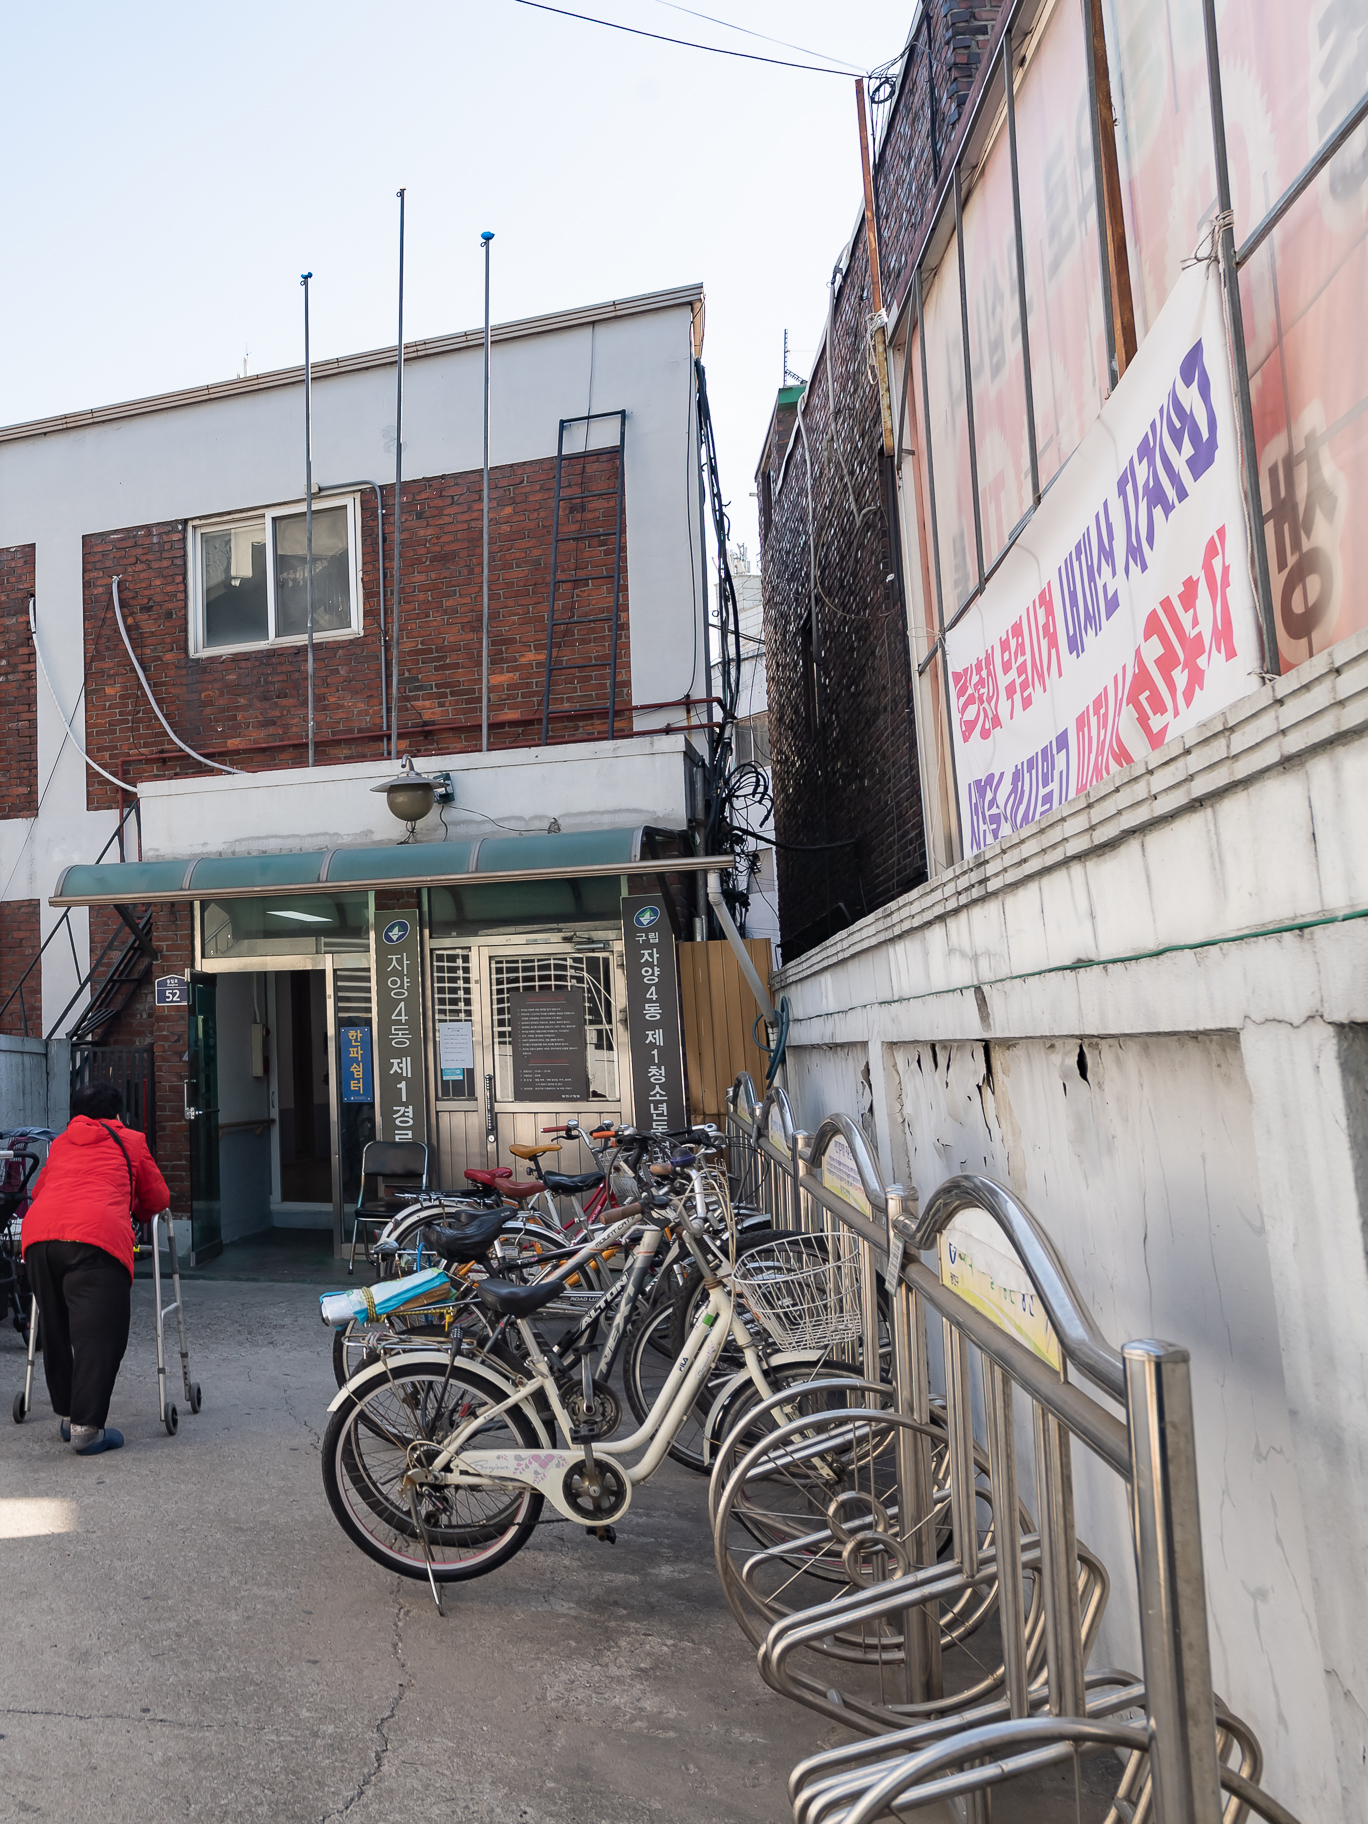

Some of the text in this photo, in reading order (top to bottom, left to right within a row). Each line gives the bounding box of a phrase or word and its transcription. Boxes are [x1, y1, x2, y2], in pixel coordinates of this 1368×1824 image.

[999, 579, 1062, 721] 부결시켜
[1058, 497, 1120, 659] 내재산
[1004, 727, 1070, 833] 하지말고
[1126, 523, 1238, 751] 권리찾자
[635, 932, 659, 944] 구립
[165, 989, 181, 1002] 52
[386, 952, 412, 1048] 자양4동
[640, 948, 662, 1021] 자양4동
[348, 1029, 364, 1094] 한파쉼터
[580, 1272, 630, 1332] ALTON
[599, 1276, 636, 1374] NEXT
[678, 1357, 689, 1372] FILA
